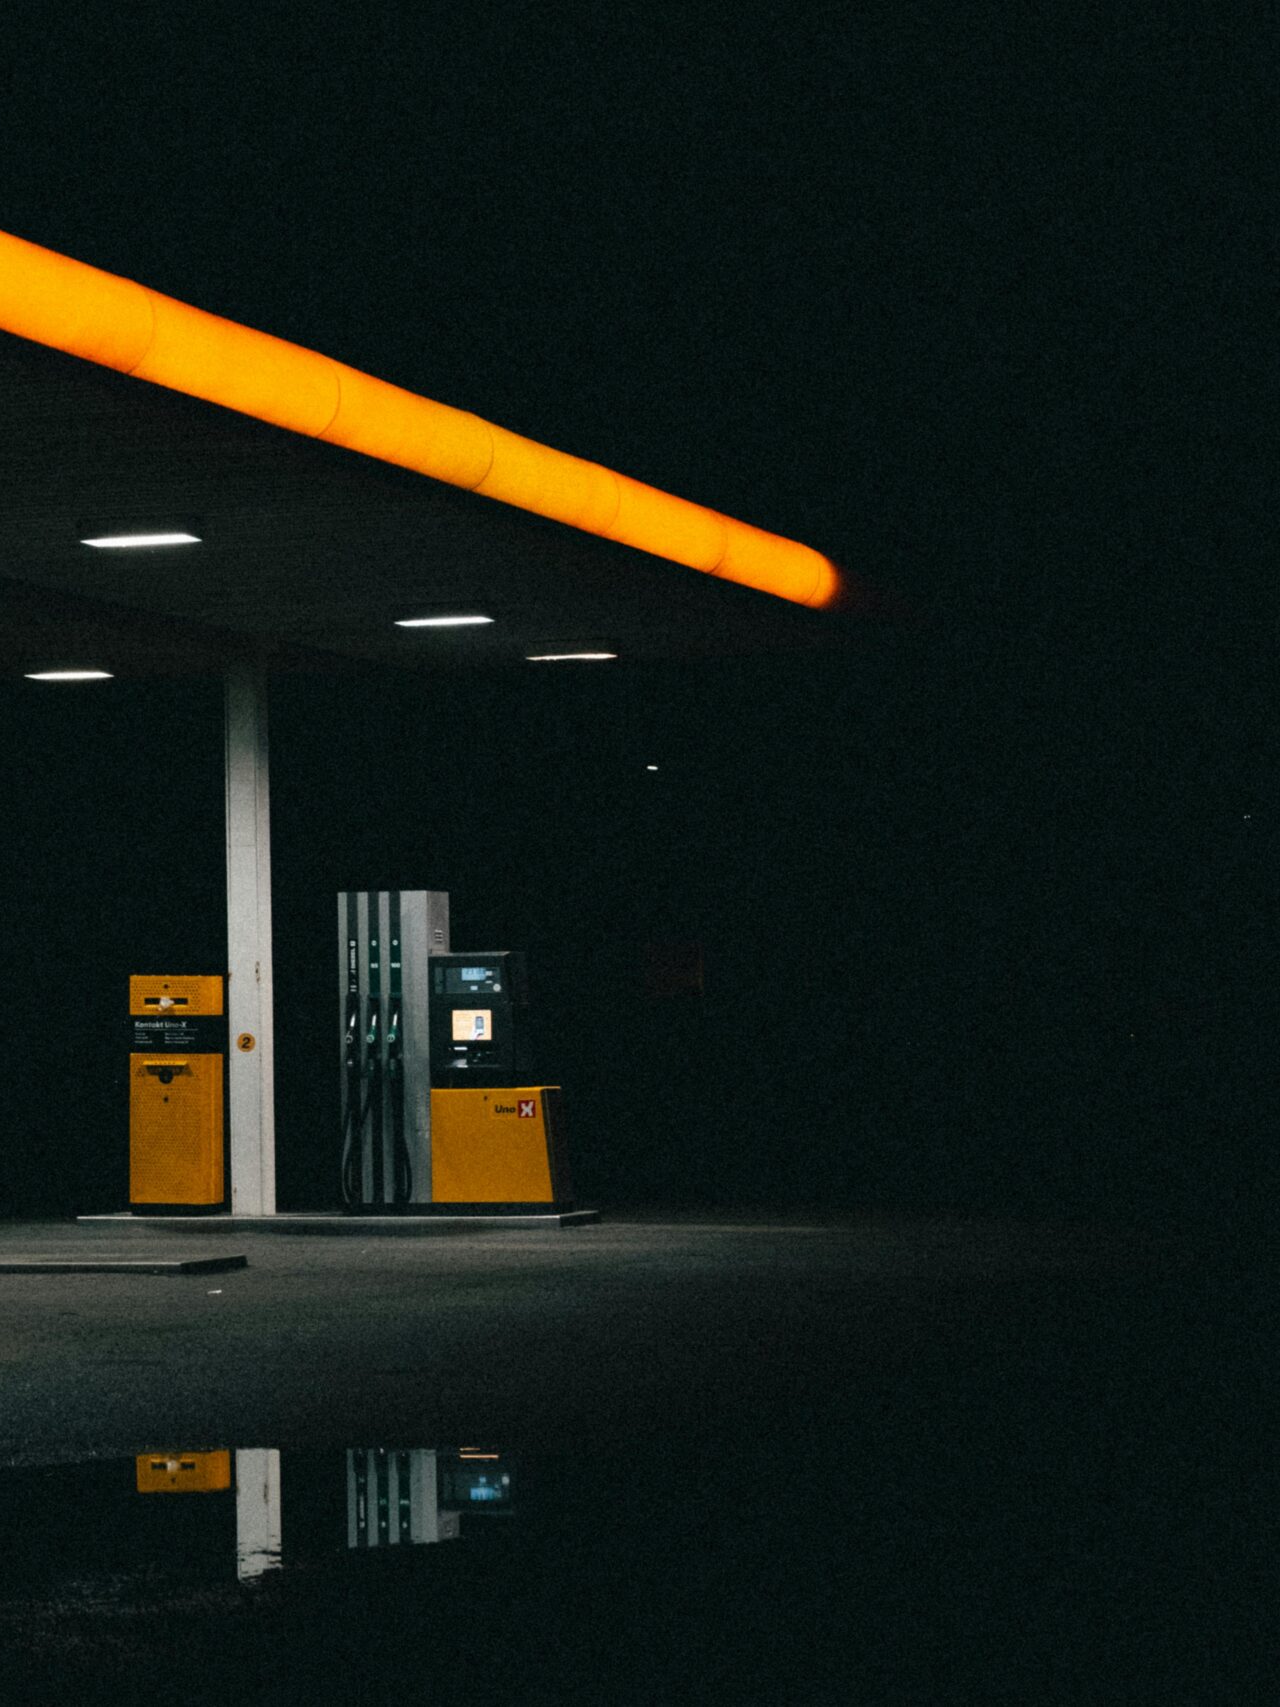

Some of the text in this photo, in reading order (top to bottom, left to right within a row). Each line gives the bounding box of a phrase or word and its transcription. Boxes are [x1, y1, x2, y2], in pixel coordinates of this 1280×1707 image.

[241, 1036, 251, 1049] 2
[495, 1101, 534, 1117] Uno X
